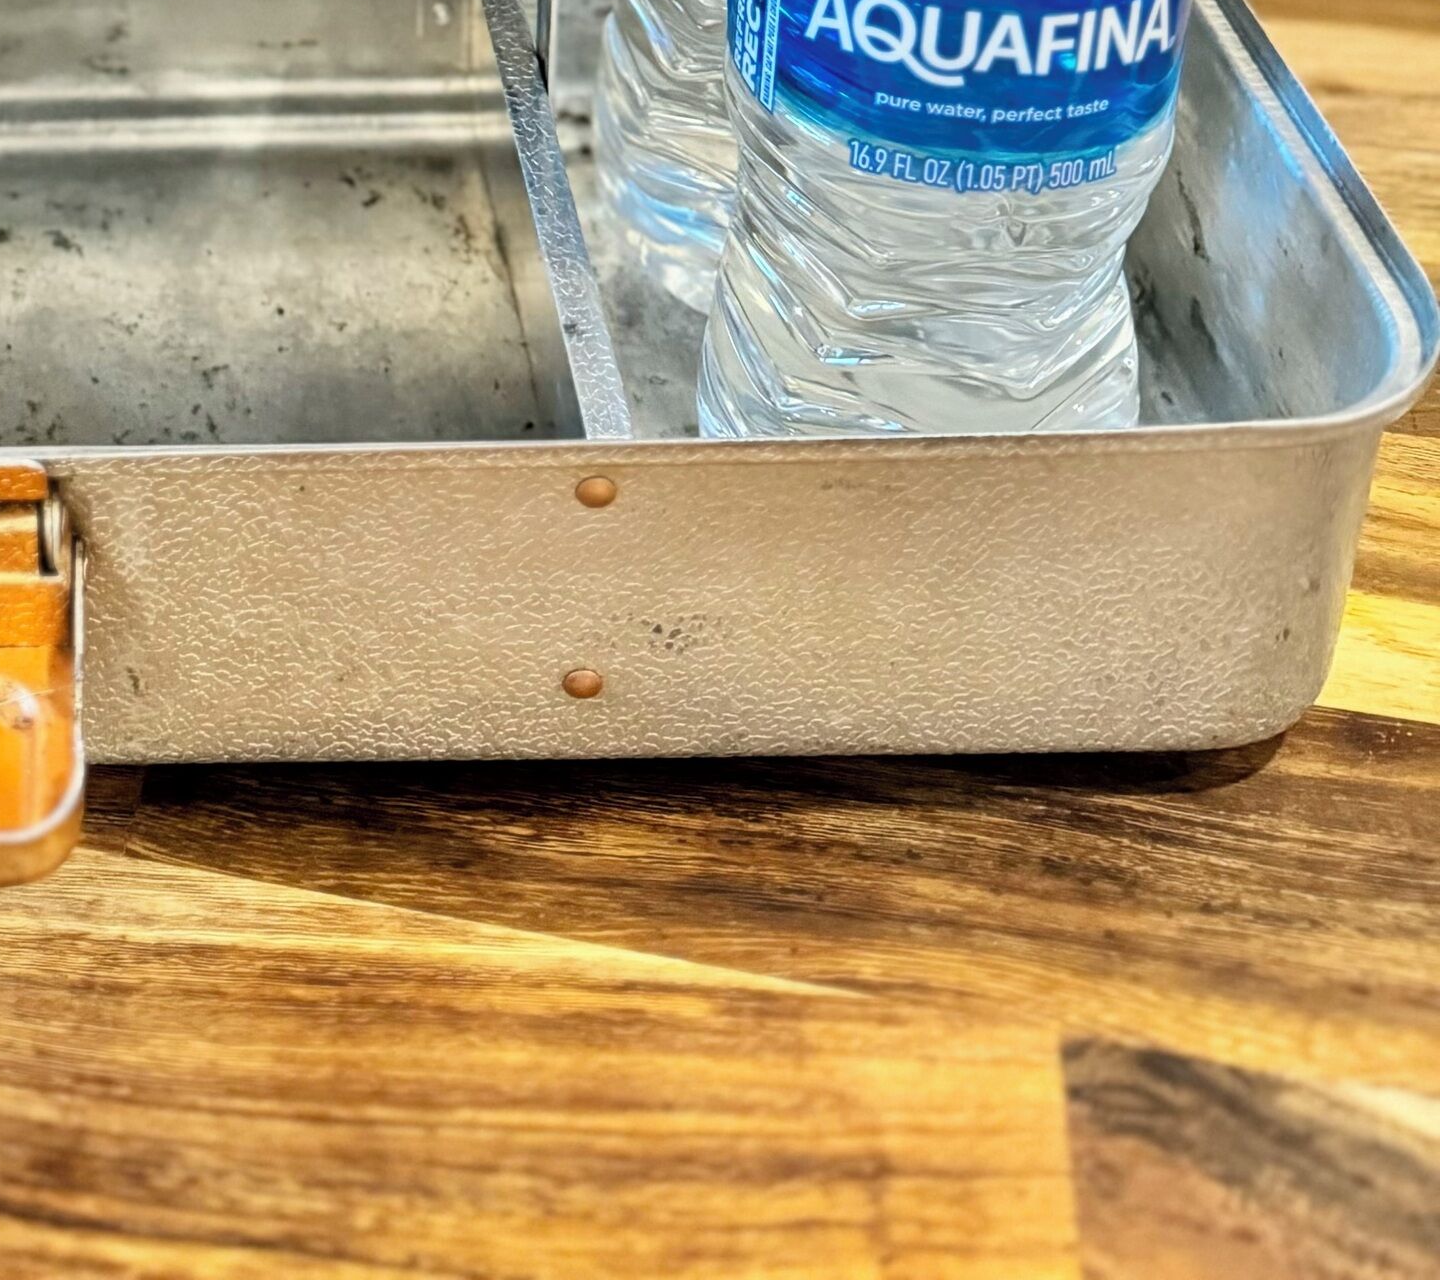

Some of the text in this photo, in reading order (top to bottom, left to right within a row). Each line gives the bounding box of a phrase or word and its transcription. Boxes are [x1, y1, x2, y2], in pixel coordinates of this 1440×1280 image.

[875, 92, 1109, 124] pure water, perfect taste
[849, 141, 1116, 194] 16.9 FL OZ (1.05 PT) 500 mL
